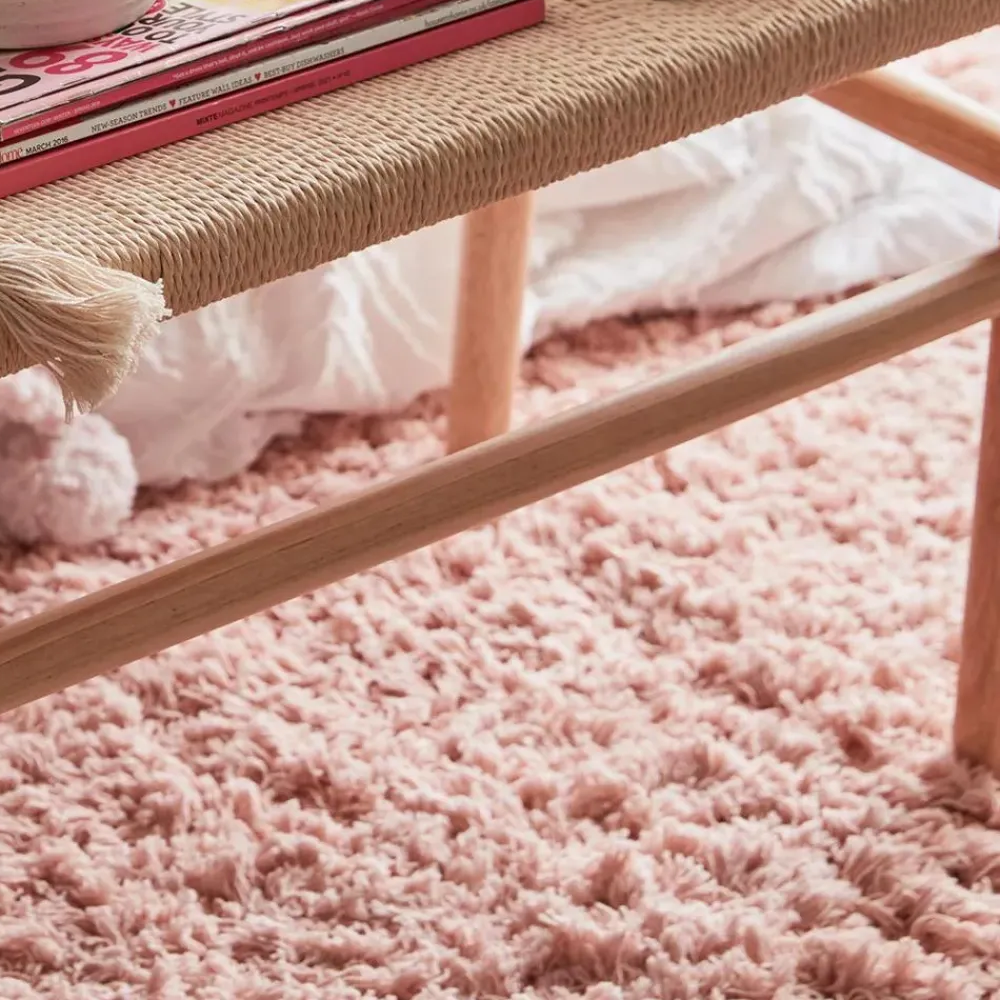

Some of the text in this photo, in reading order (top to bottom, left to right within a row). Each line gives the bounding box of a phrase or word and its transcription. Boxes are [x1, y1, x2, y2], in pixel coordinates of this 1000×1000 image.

[138, 12, 207, 35] YOUR
[162, 2, 247, 28] STYLE
[144, 28, 186, 46] TO
[9, 40, 128, 76] 89
[264, 63, 296, 79] BEST-BUY
[296, 47, 345, 68] DISHWASHERS
[178, 76, 253, 105] FEATURE WALL IDEAS
[91, 102, 168, 133] NEW-SEASON TRENDS
[196, 112, 219, 126] MIXTE
[218, 101, 254, 119] MAGAZINE
[25, 141, 52, 155] MARCH
[53, 136, 69, 148] 2016
